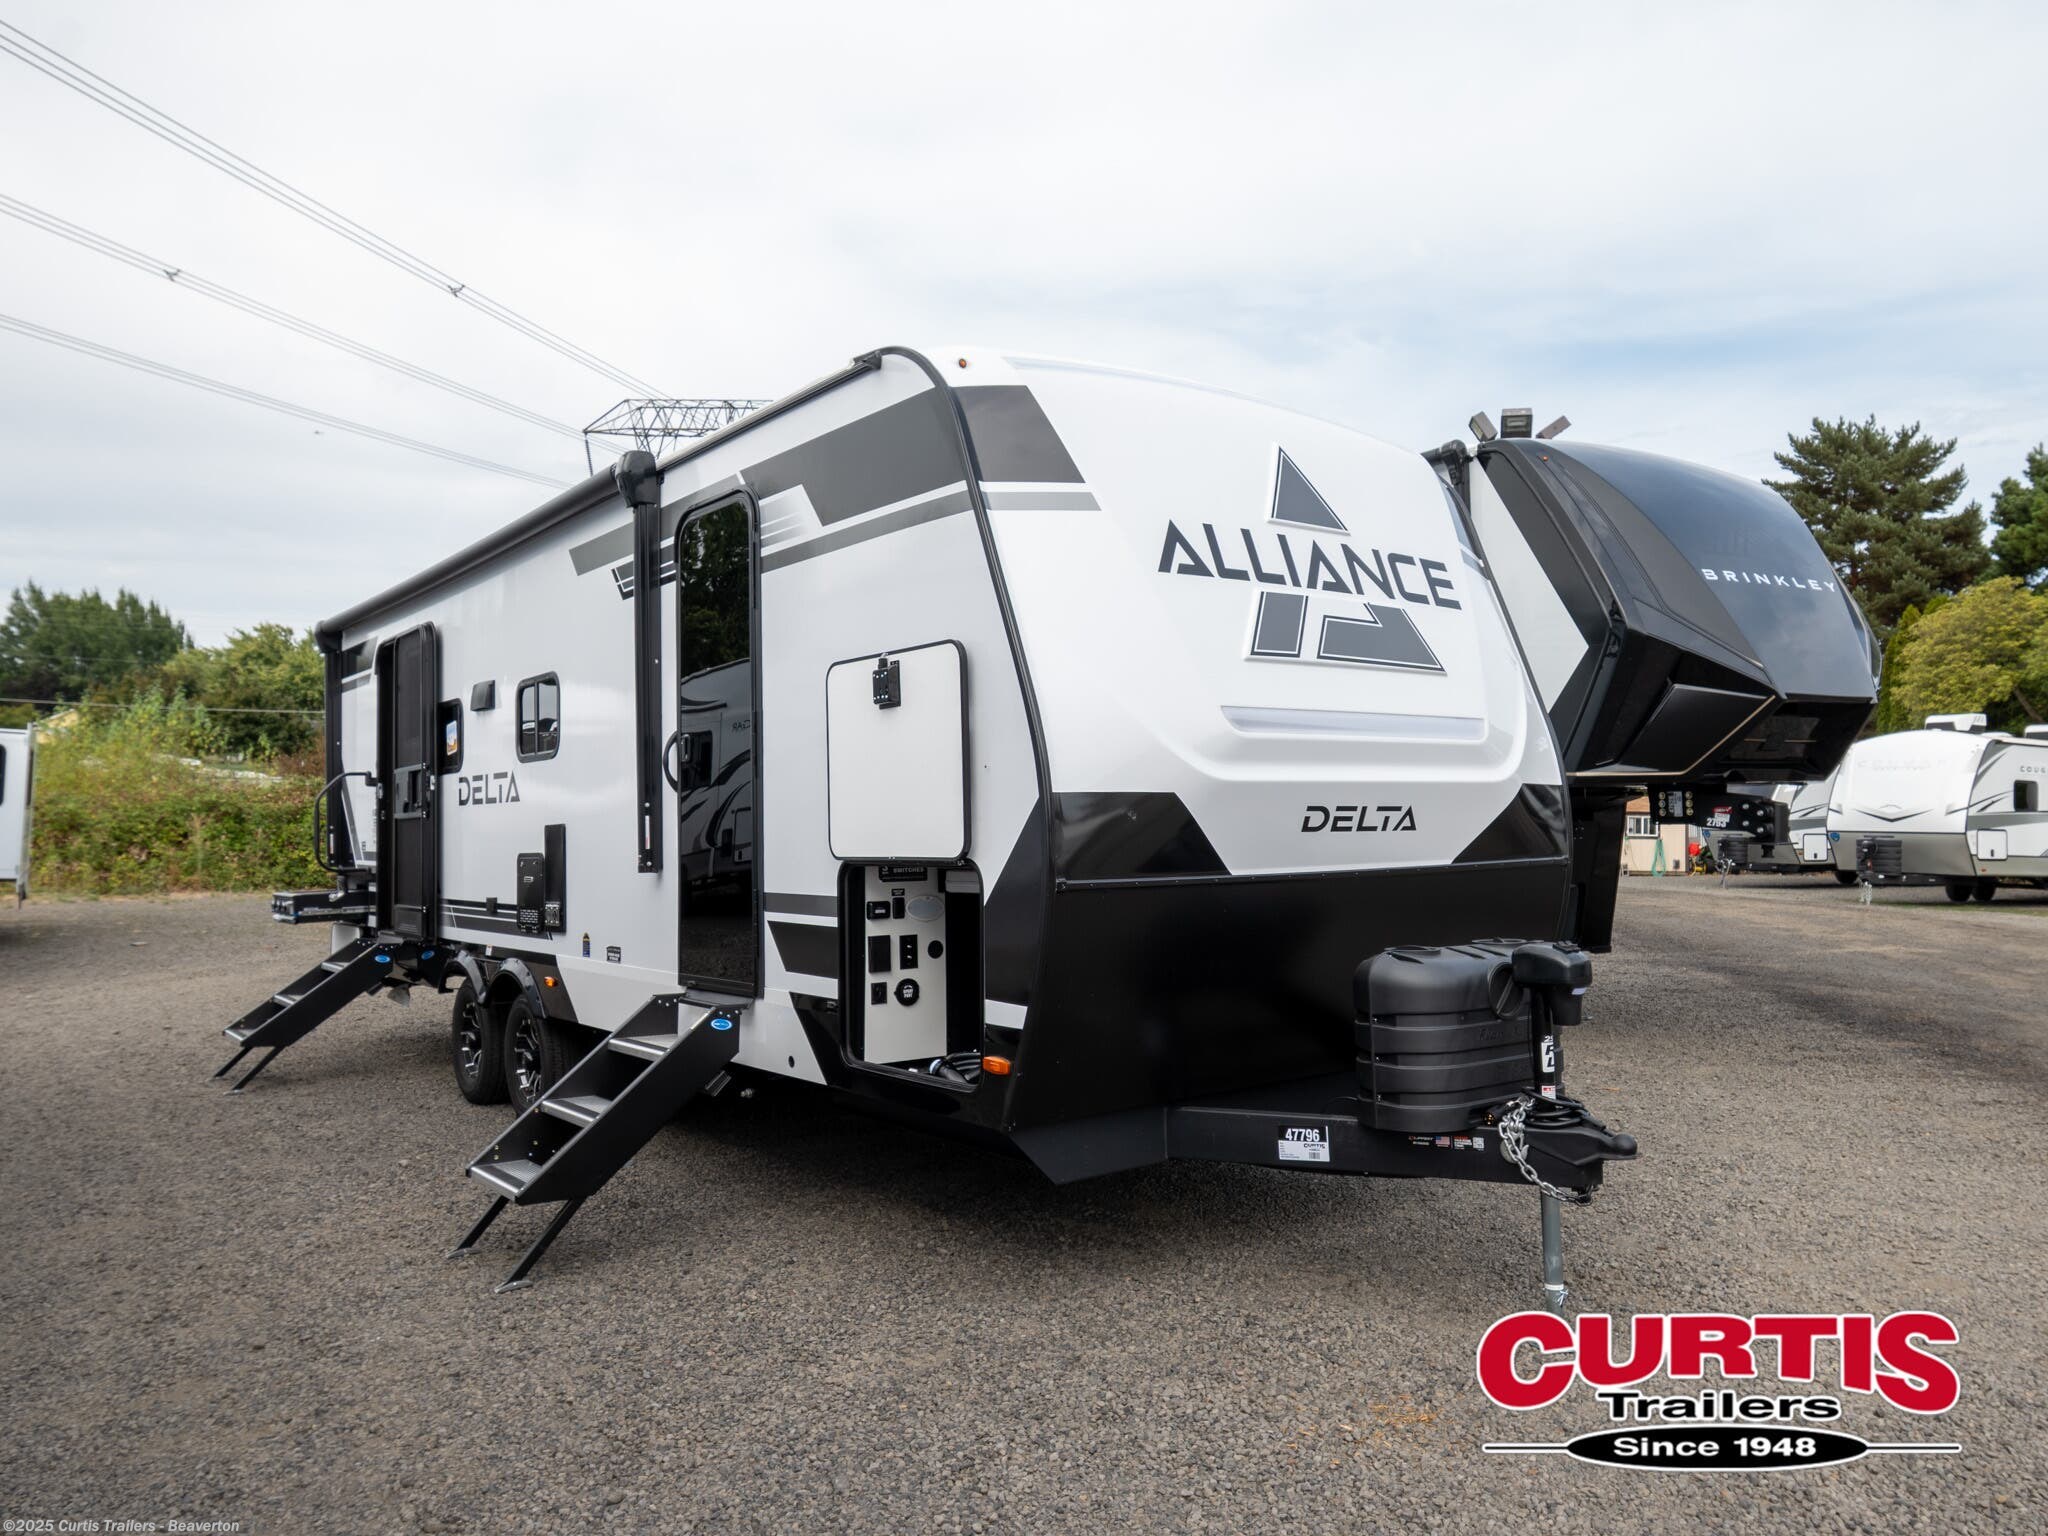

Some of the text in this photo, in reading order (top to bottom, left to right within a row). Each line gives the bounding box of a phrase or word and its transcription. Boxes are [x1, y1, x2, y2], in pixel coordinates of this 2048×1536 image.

[1157, 519, 1463, 610] ALLIANCE
[1701, 568, 1836, 593] BRINKLEY
[459, 770, 521, 806] DELTA
[1301, 805, 1417, 832] DELTA
[1285, 1128, 1320, 1142] 47796
